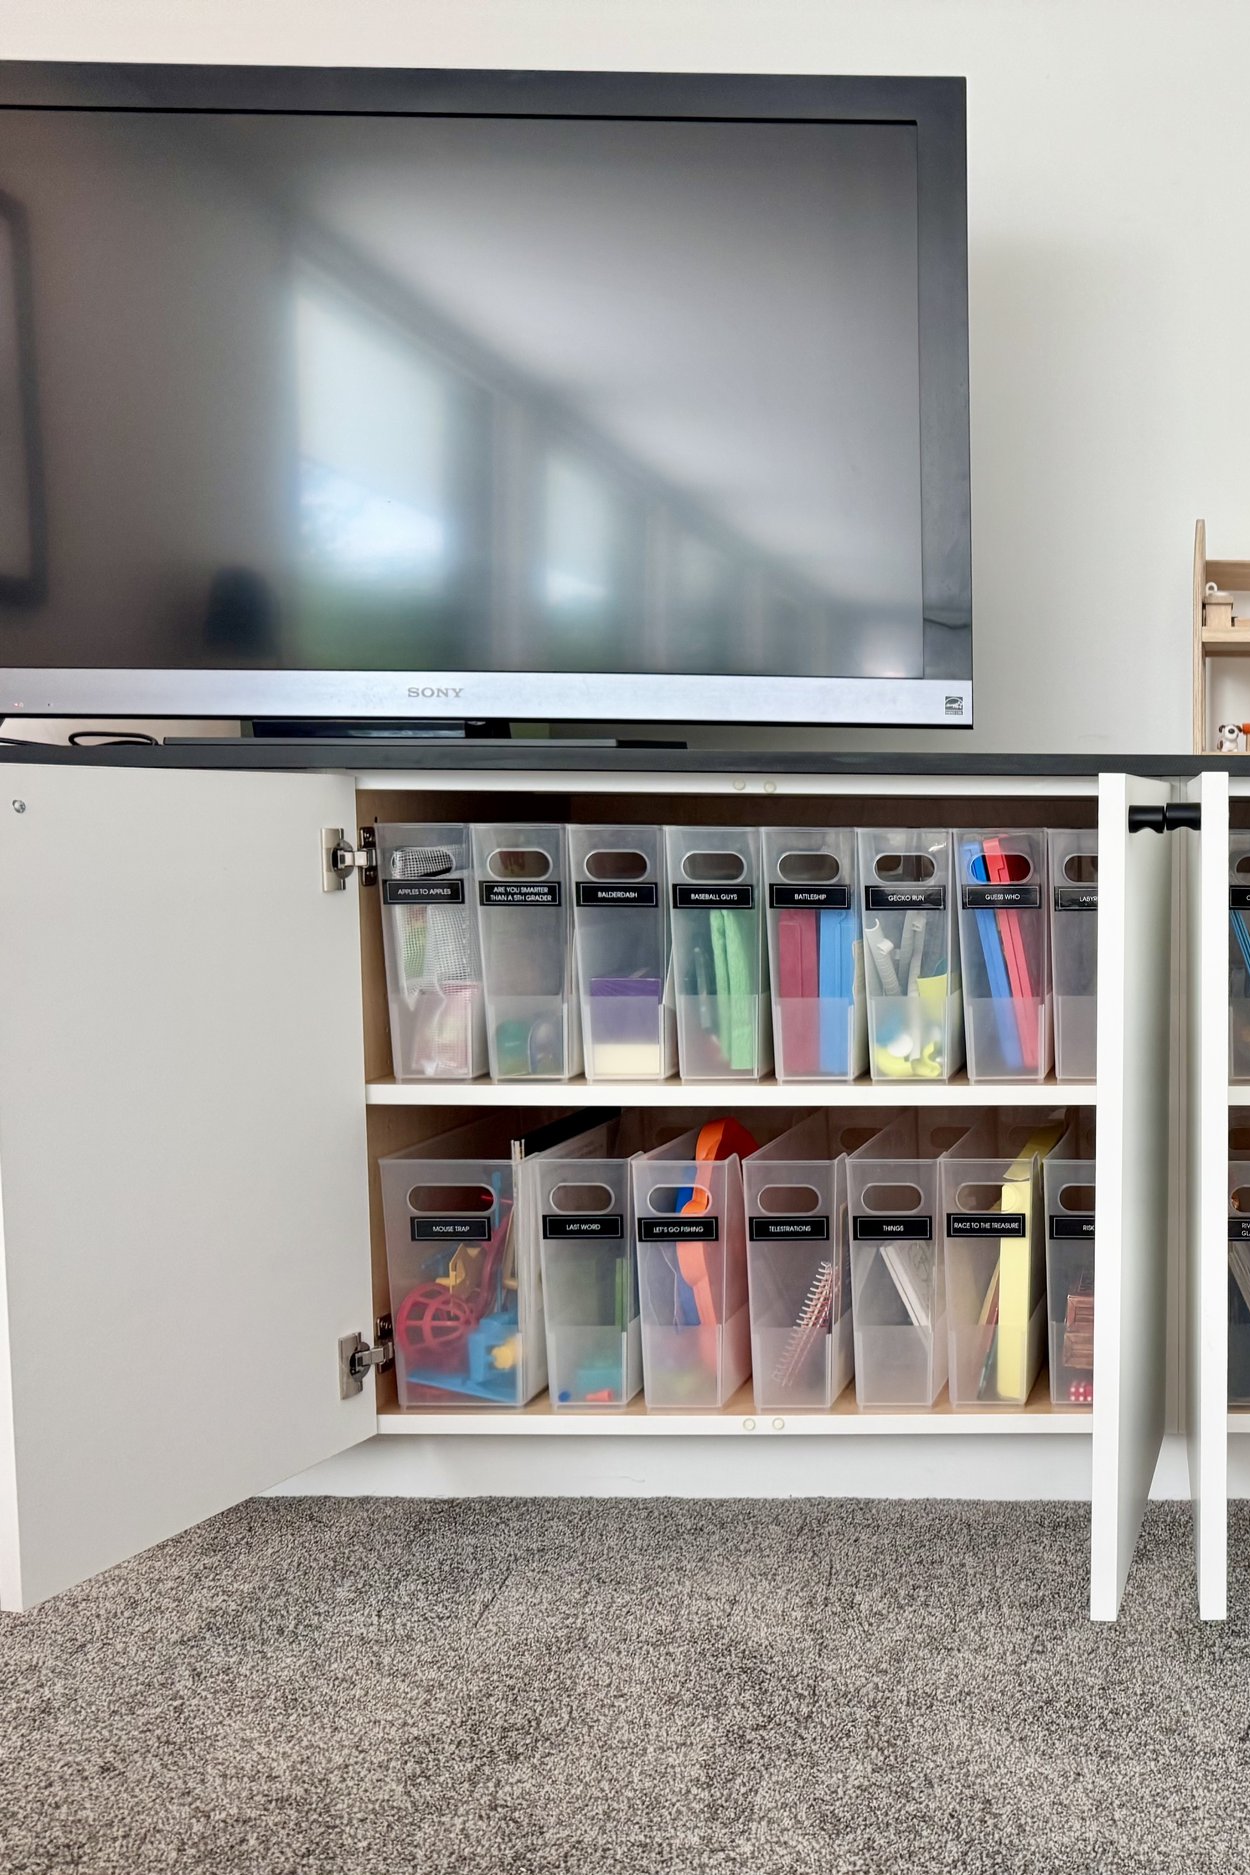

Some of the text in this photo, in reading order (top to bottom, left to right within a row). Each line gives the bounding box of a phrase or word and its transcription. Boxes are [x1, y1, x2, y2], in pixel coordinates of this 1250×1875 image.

[407, 687, 464, 698] SONY
[397, 888, 420, 896] APPLES
[429, 888, 451, 896] APPLES
[493, 886, 549, 894] ARE YOU SMARTER
[490, 894, 507, 902] THAN
[525, 894, 552, 902] GRADER
[597, 891, 638, 899] BALDERDASH
[691, 893, 738, 901] BASEBALL GUYS
[794, 893, 827, 901] BATTLESHIP
[888, 894, 925, 902] GECKO RUN
[985, 893, 1003, 901] GUESS
[432, 1225, 470, 1233] MOUSE TRAP
[566, 1223, 601, 1231] LAST WORD
[653, 1225, 668, 1234] LET'S
[680, 1225, 704, 1234] FISHING
[768, 1225, 811, 1233] TELESTRATIONS
[954, 1221, 970, 1230] RACE
[980, 1222, 991, 1230] THE
[991, 1222, 1020, 1230] TREASURE
